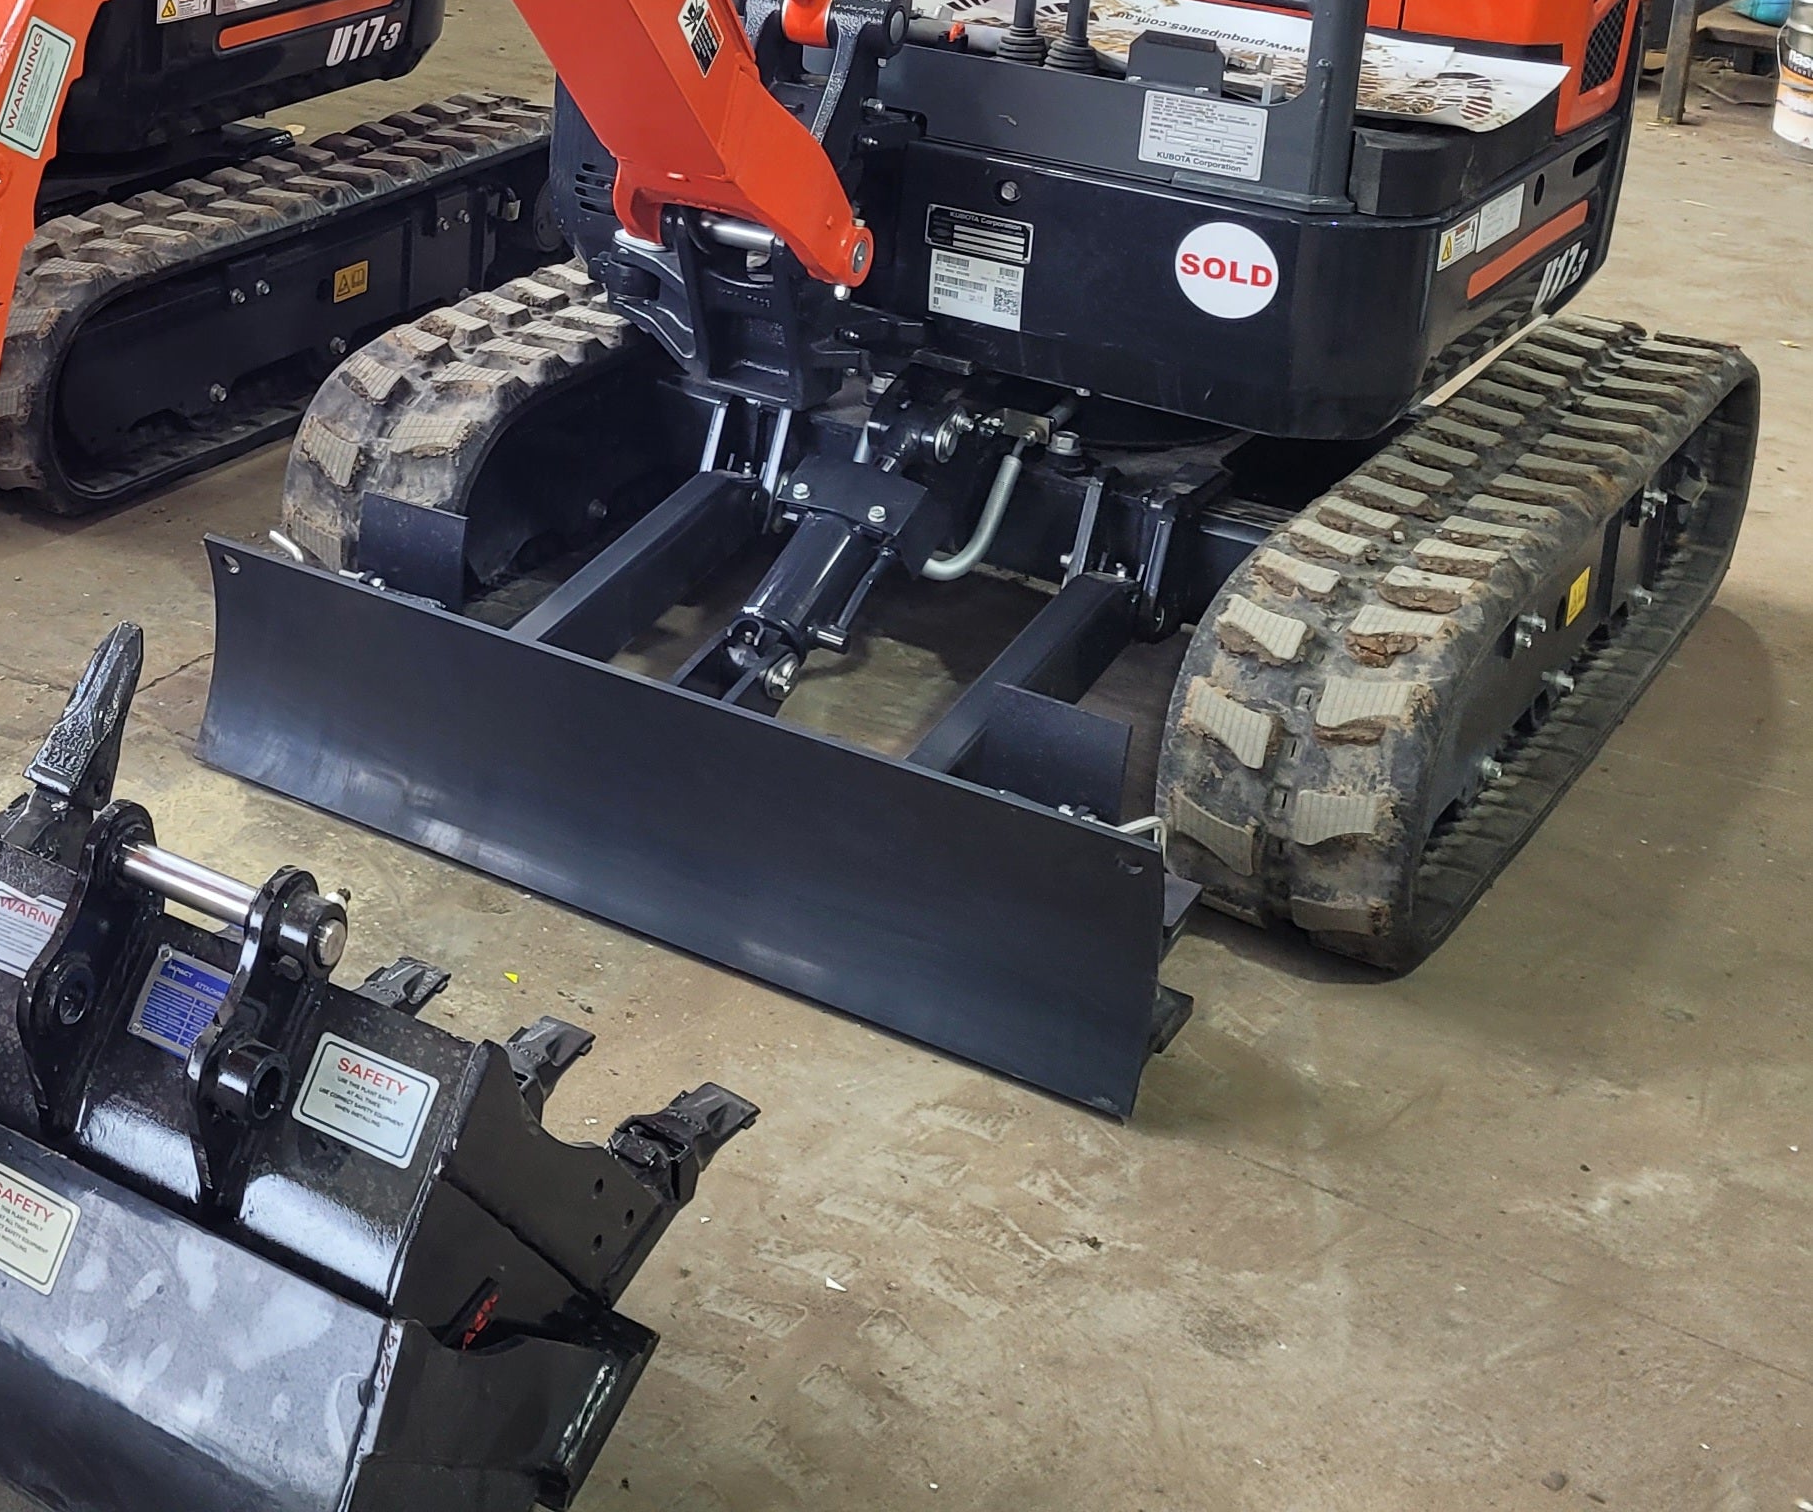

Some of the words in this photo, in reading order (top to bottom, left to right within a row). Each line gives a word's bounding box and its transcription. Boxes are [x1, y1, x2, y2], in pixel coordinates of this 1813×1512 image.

[325, 15, 402, 67] U17-3
[1117, 11, 1306, 54] www.proquipsales.com.au
[6, 32, 43, 129] WARNING
[1157, 151, 1191, 164] KUBOTA
[1193, 158, 1242, 173] Corporation
[950, 211, 979, 223] KUBOTA
[981, 218, 1022, 231] Corporation
[1180, 253, 1273, 287] SOLD
[0, 897, 56, 927] WARNI
[338, 1057, 409, 1096] SAFETY
[361, 1084, 377, 1098] PLANT
